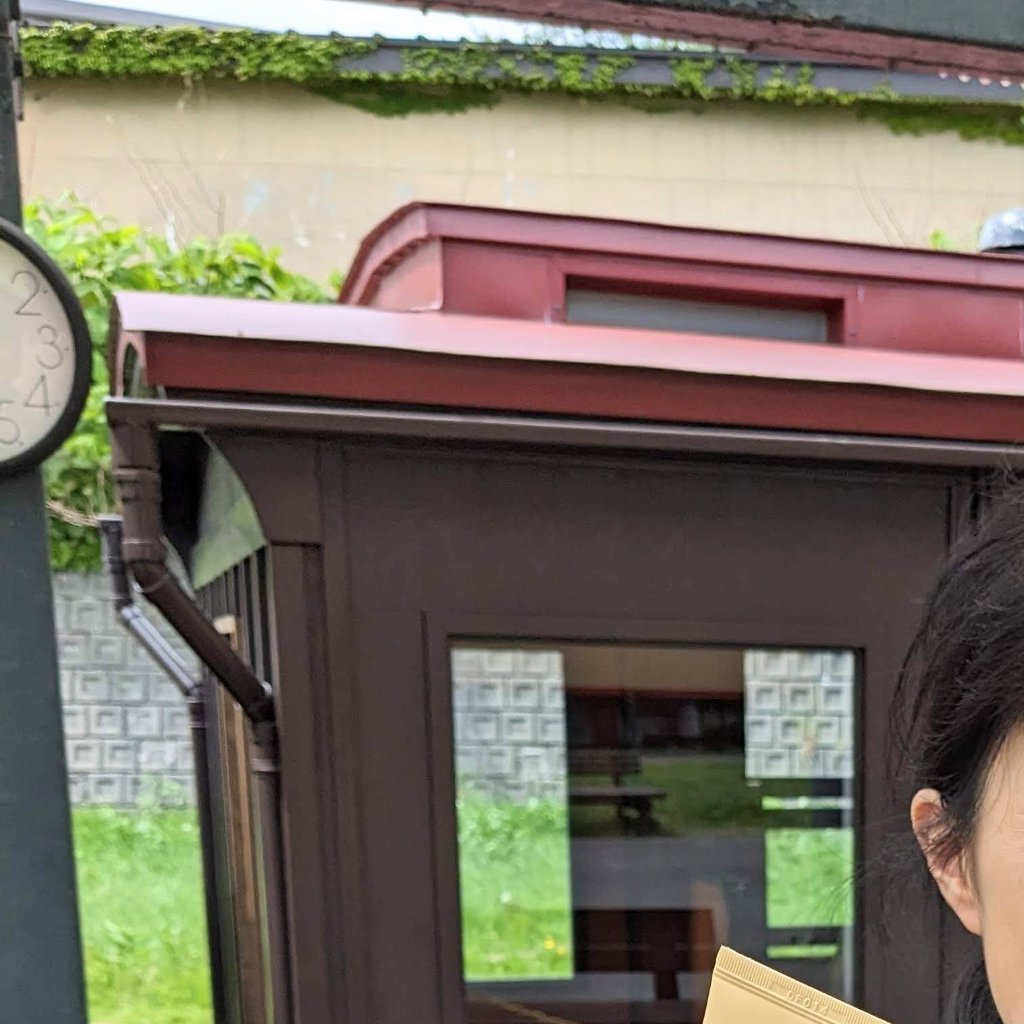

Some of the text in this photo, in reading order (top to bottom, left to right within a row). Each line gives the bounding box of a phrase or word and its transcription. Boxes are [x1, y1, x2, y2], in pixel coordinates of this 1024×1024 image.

[10, 269, 42, 317] 2
[36, 324, 64, 370] 3
[24, 374, 53, 417] 4
